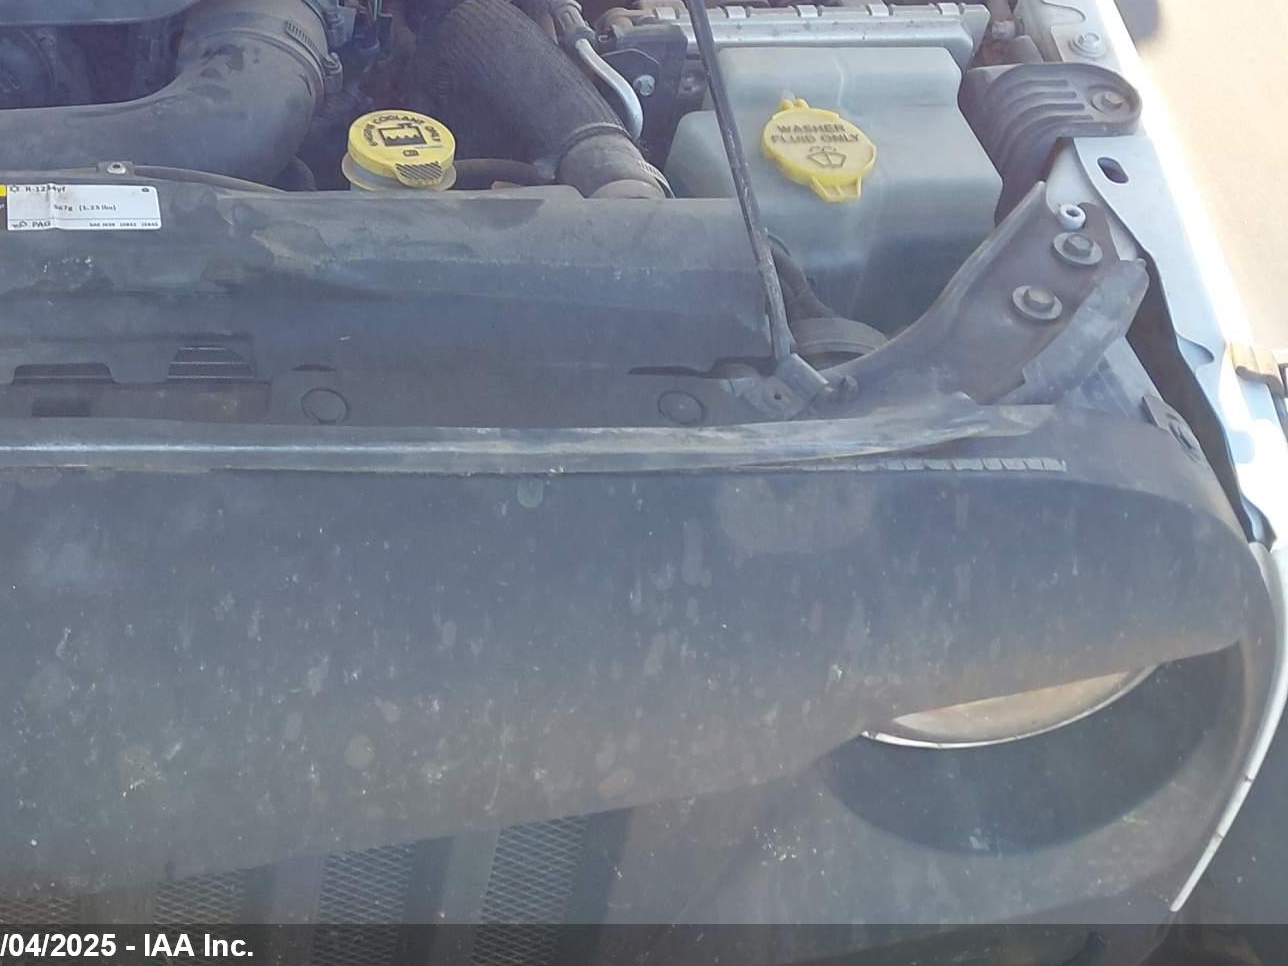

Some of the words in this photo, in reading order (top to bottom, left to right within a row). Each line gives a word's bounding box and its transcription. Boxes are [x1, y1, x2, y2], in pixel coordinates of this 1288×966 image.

[373, 115, 425, 124] COOLANT
[776, 123, 846, 133] WASHER
[771, 134, 817, 144] FLUID
[820, 133, 859, 143] ONLY
